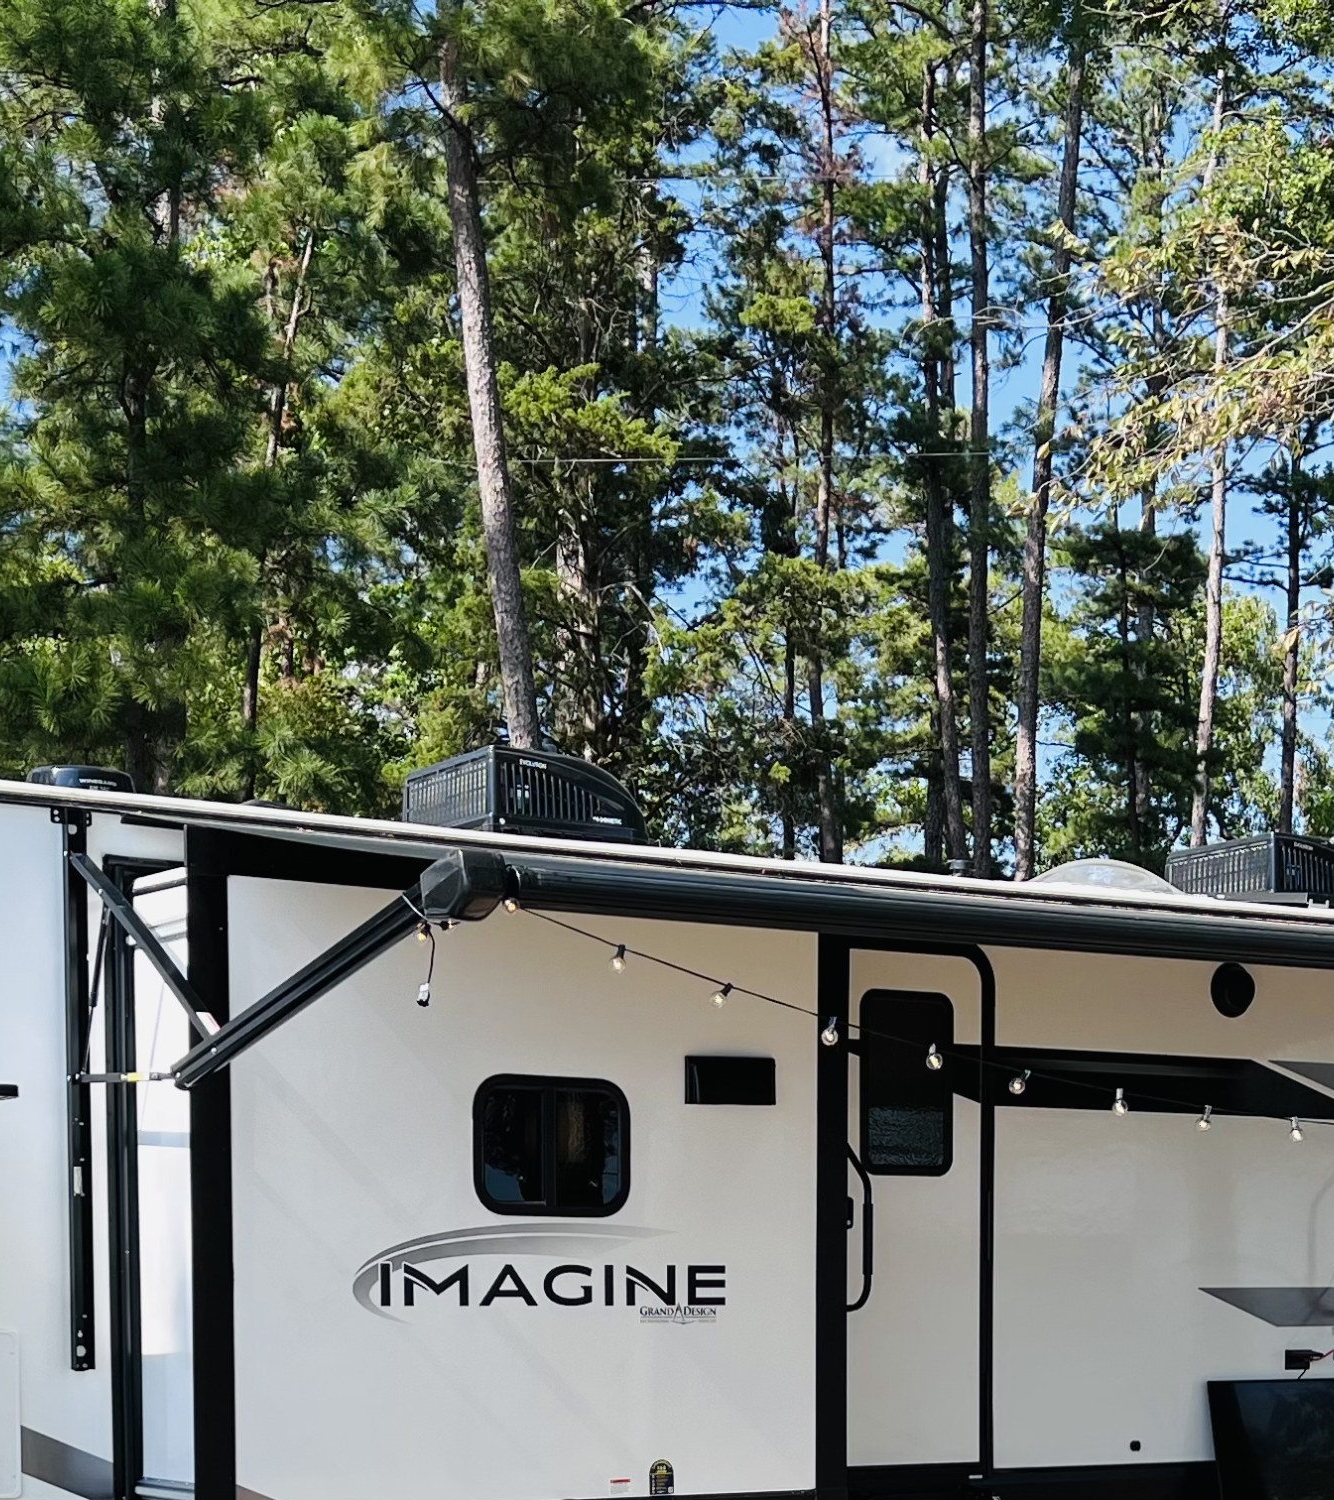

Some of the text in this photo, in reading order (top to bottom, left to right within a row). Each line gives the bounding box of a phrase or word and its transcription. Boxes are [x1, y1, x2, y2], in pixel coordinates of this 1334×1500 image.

[379, 1261, 727, 1307] IMAGINE
[639, 1305, 717, 1317] GRAND DESIGN
